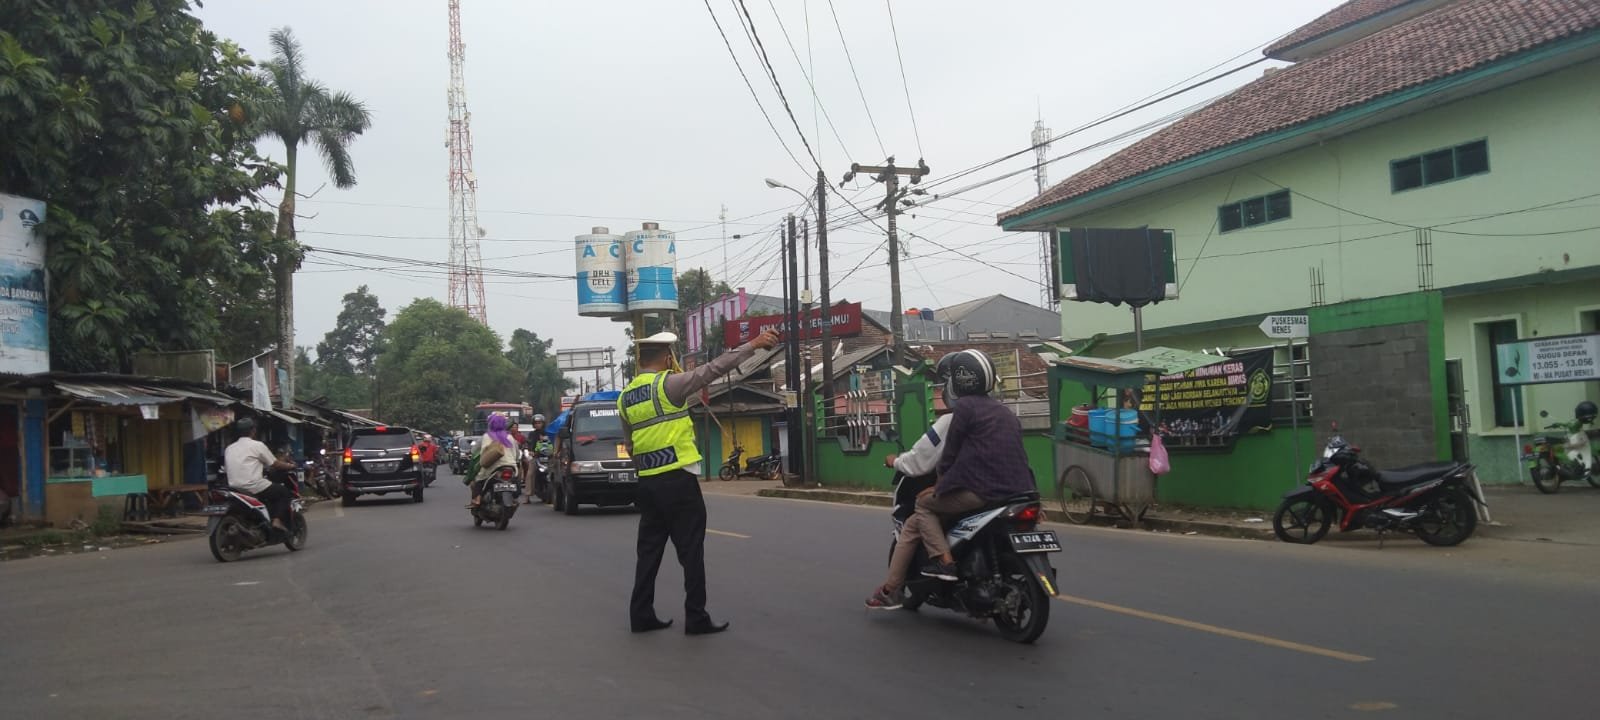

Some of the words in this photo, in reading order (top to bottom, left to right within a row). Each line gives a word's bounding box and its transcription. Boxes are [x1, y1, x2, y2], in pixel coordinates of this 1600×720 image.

[1271, 316, 1307, 325] PUSKESMAS
[1271, 325, 1292, 334] MENES
[1536, 351, 1561, 359] GUGUS
[1223, 362, 1244, 374] KERAS
[1532, 361, 1559, 370] 13.055
[1566, 358, 1594, 367] 13.056
[625, 384, 651, 406] POLISI
